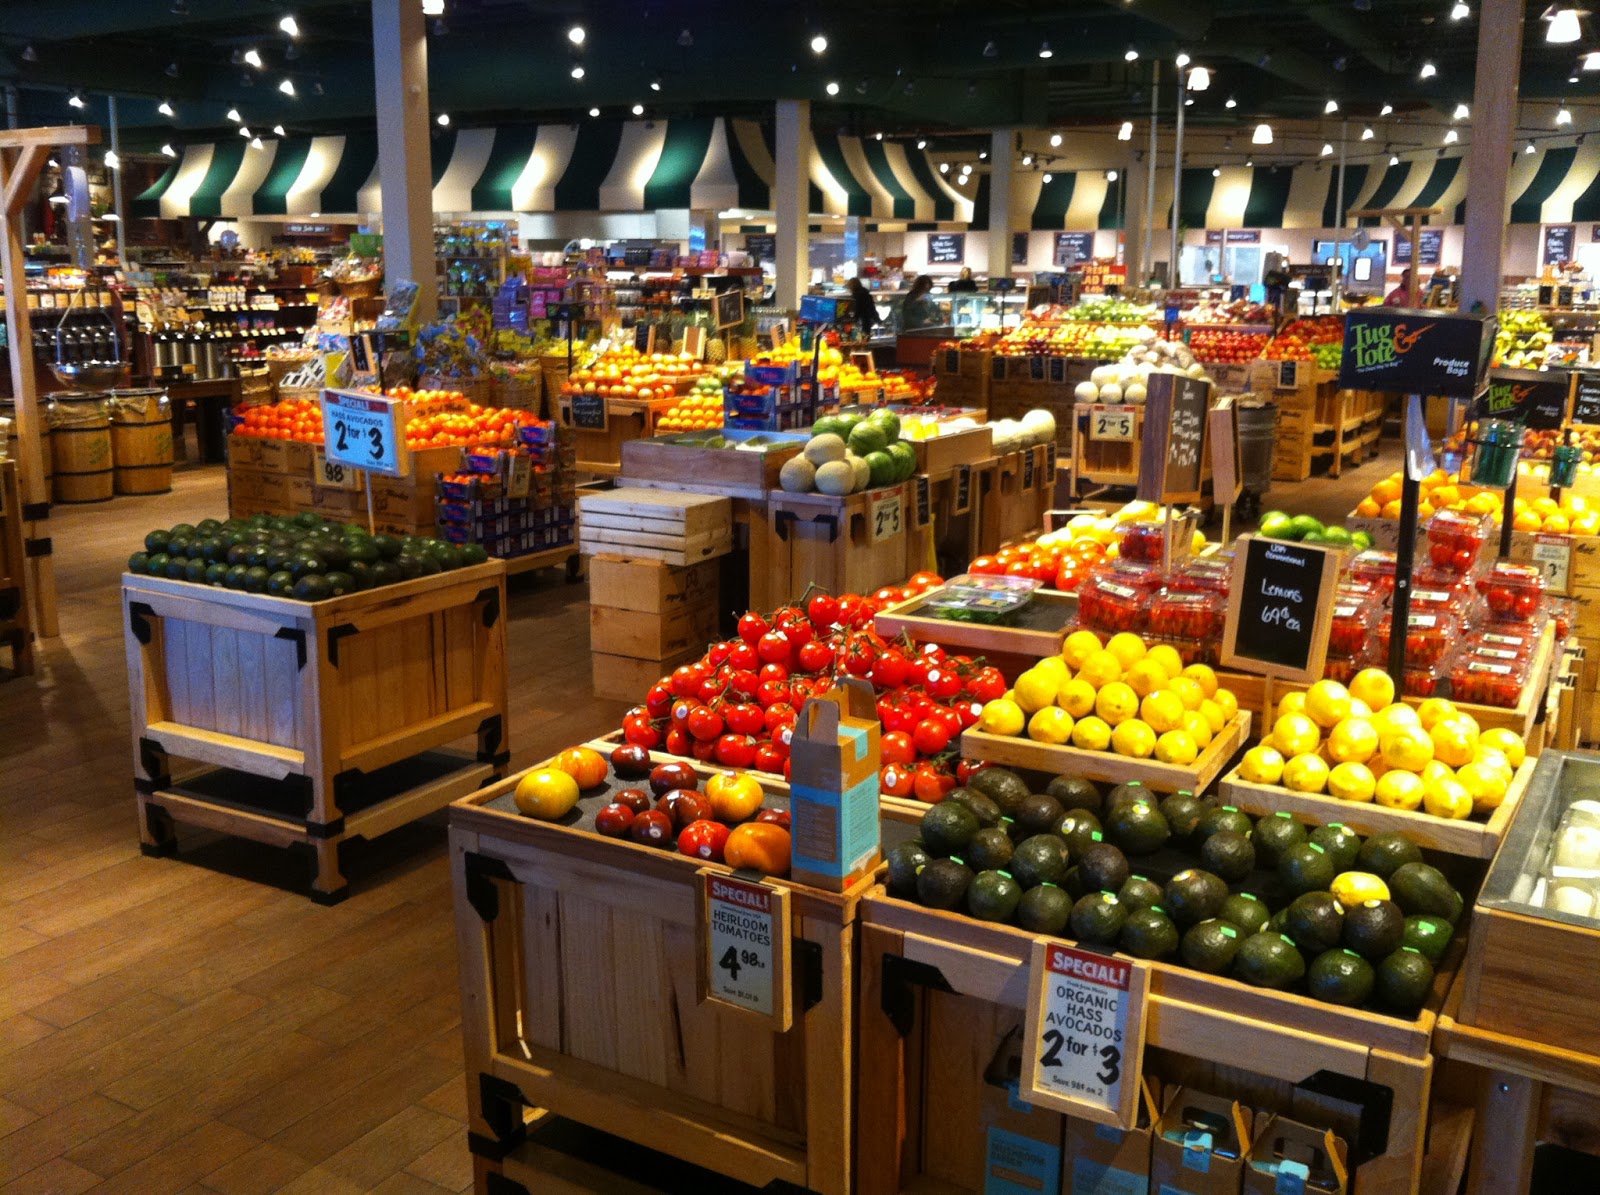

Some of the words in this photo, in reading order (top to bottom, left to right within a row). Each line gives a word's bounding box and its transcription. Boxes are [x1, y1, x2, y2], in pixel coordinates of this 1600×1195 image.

[1351, 323, 1391, 349] Tug
[1350, 341, 1397, 368] Tote
[1433, 357, 1470, 368] Produce
[1446, 365, 1468, 377] Bags
[347, 414, 383, 427] AVOCADOS
[1098, 419, 1106, 434] 2
[335, 420, 349, 452] 2
[347, 424, 361, 440] for
[876, 511, 884, 536] 2
[712, 881, 769, 909] SPECIAL!
[712, 920, 771, 946] TOMATOES
[713, 909, 768, 934] HEIRLOOM
[1052, 952, 1126, 985] SPECIAL!
[1056, 986, 1118, 1012] ORGANIC
[1067, 1003, 1103, 1022] HASS
[1046, 1012, 1122, 1042] AVOCADOS
[1040, 1029, 1064, 1067] 2
[1066, 1036, 1089, 1056] for
[1052, 1075, 1069, 1087] Save
[1097, 1087, 1103, 1097] 2
